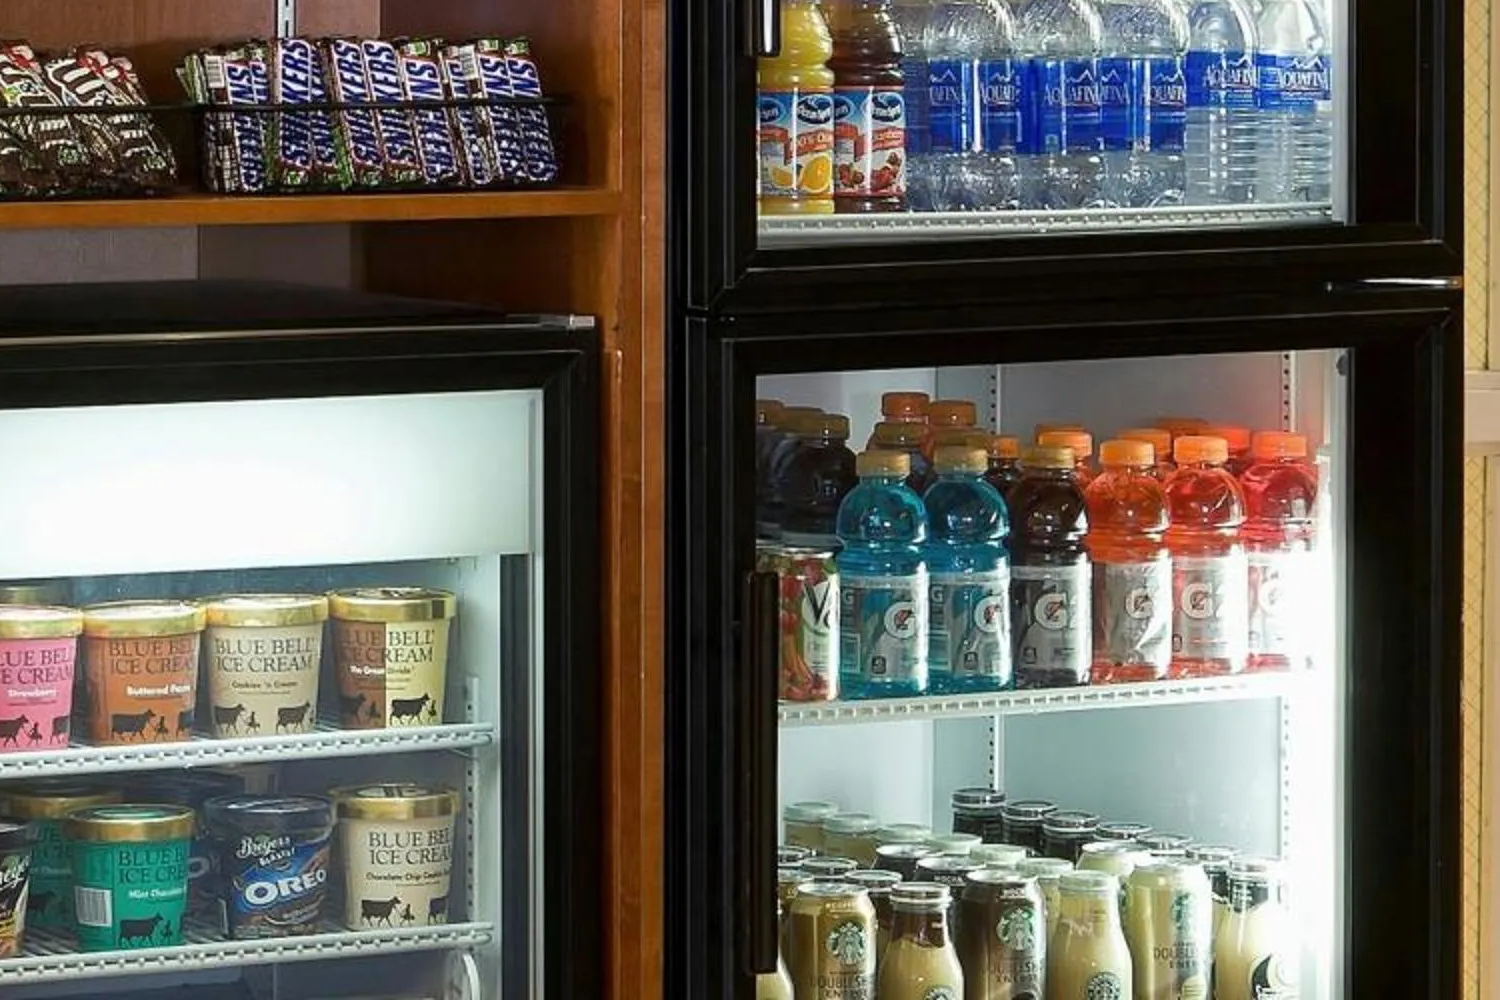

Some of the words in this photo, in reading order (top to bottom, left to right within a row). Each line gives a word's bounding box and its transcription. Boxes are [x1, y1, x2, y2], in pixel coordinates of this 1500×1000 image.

[405, 61, 458, 183] SNCKERS
[215, 637, 267, 655] BLUE
[272, 636, 314, 655] BELL
[388, 628, 435, 647] BELL
[40, 647, 72, 667] BEL
[109, 639, 166, 657] BLUE
[366, 646, 434, 664] CREAM
[110, 657, 143, 675] ICE
[216, 655, 244, 673] ICE
[249, 653, 313, 673] CREAM
[7, 688, 57, 698] Strawberry
[127, 684, 169, 697] Buttered
[236, 834, 292, 860] Breyers
[369, 830, 421, 849] BLUE
[119, 849, 170, 867] BLUE
[370, 849, 400, 866] ICE
[405, 846, 452, 865] CREA
[119, 866, 153, 883] ICE
[156, 864, 185, 882] CRE
[365, 871, 402, 882] Chocolate
[129, 888, 148, 899] Mint
[245, 868, 328, 905] OREO
